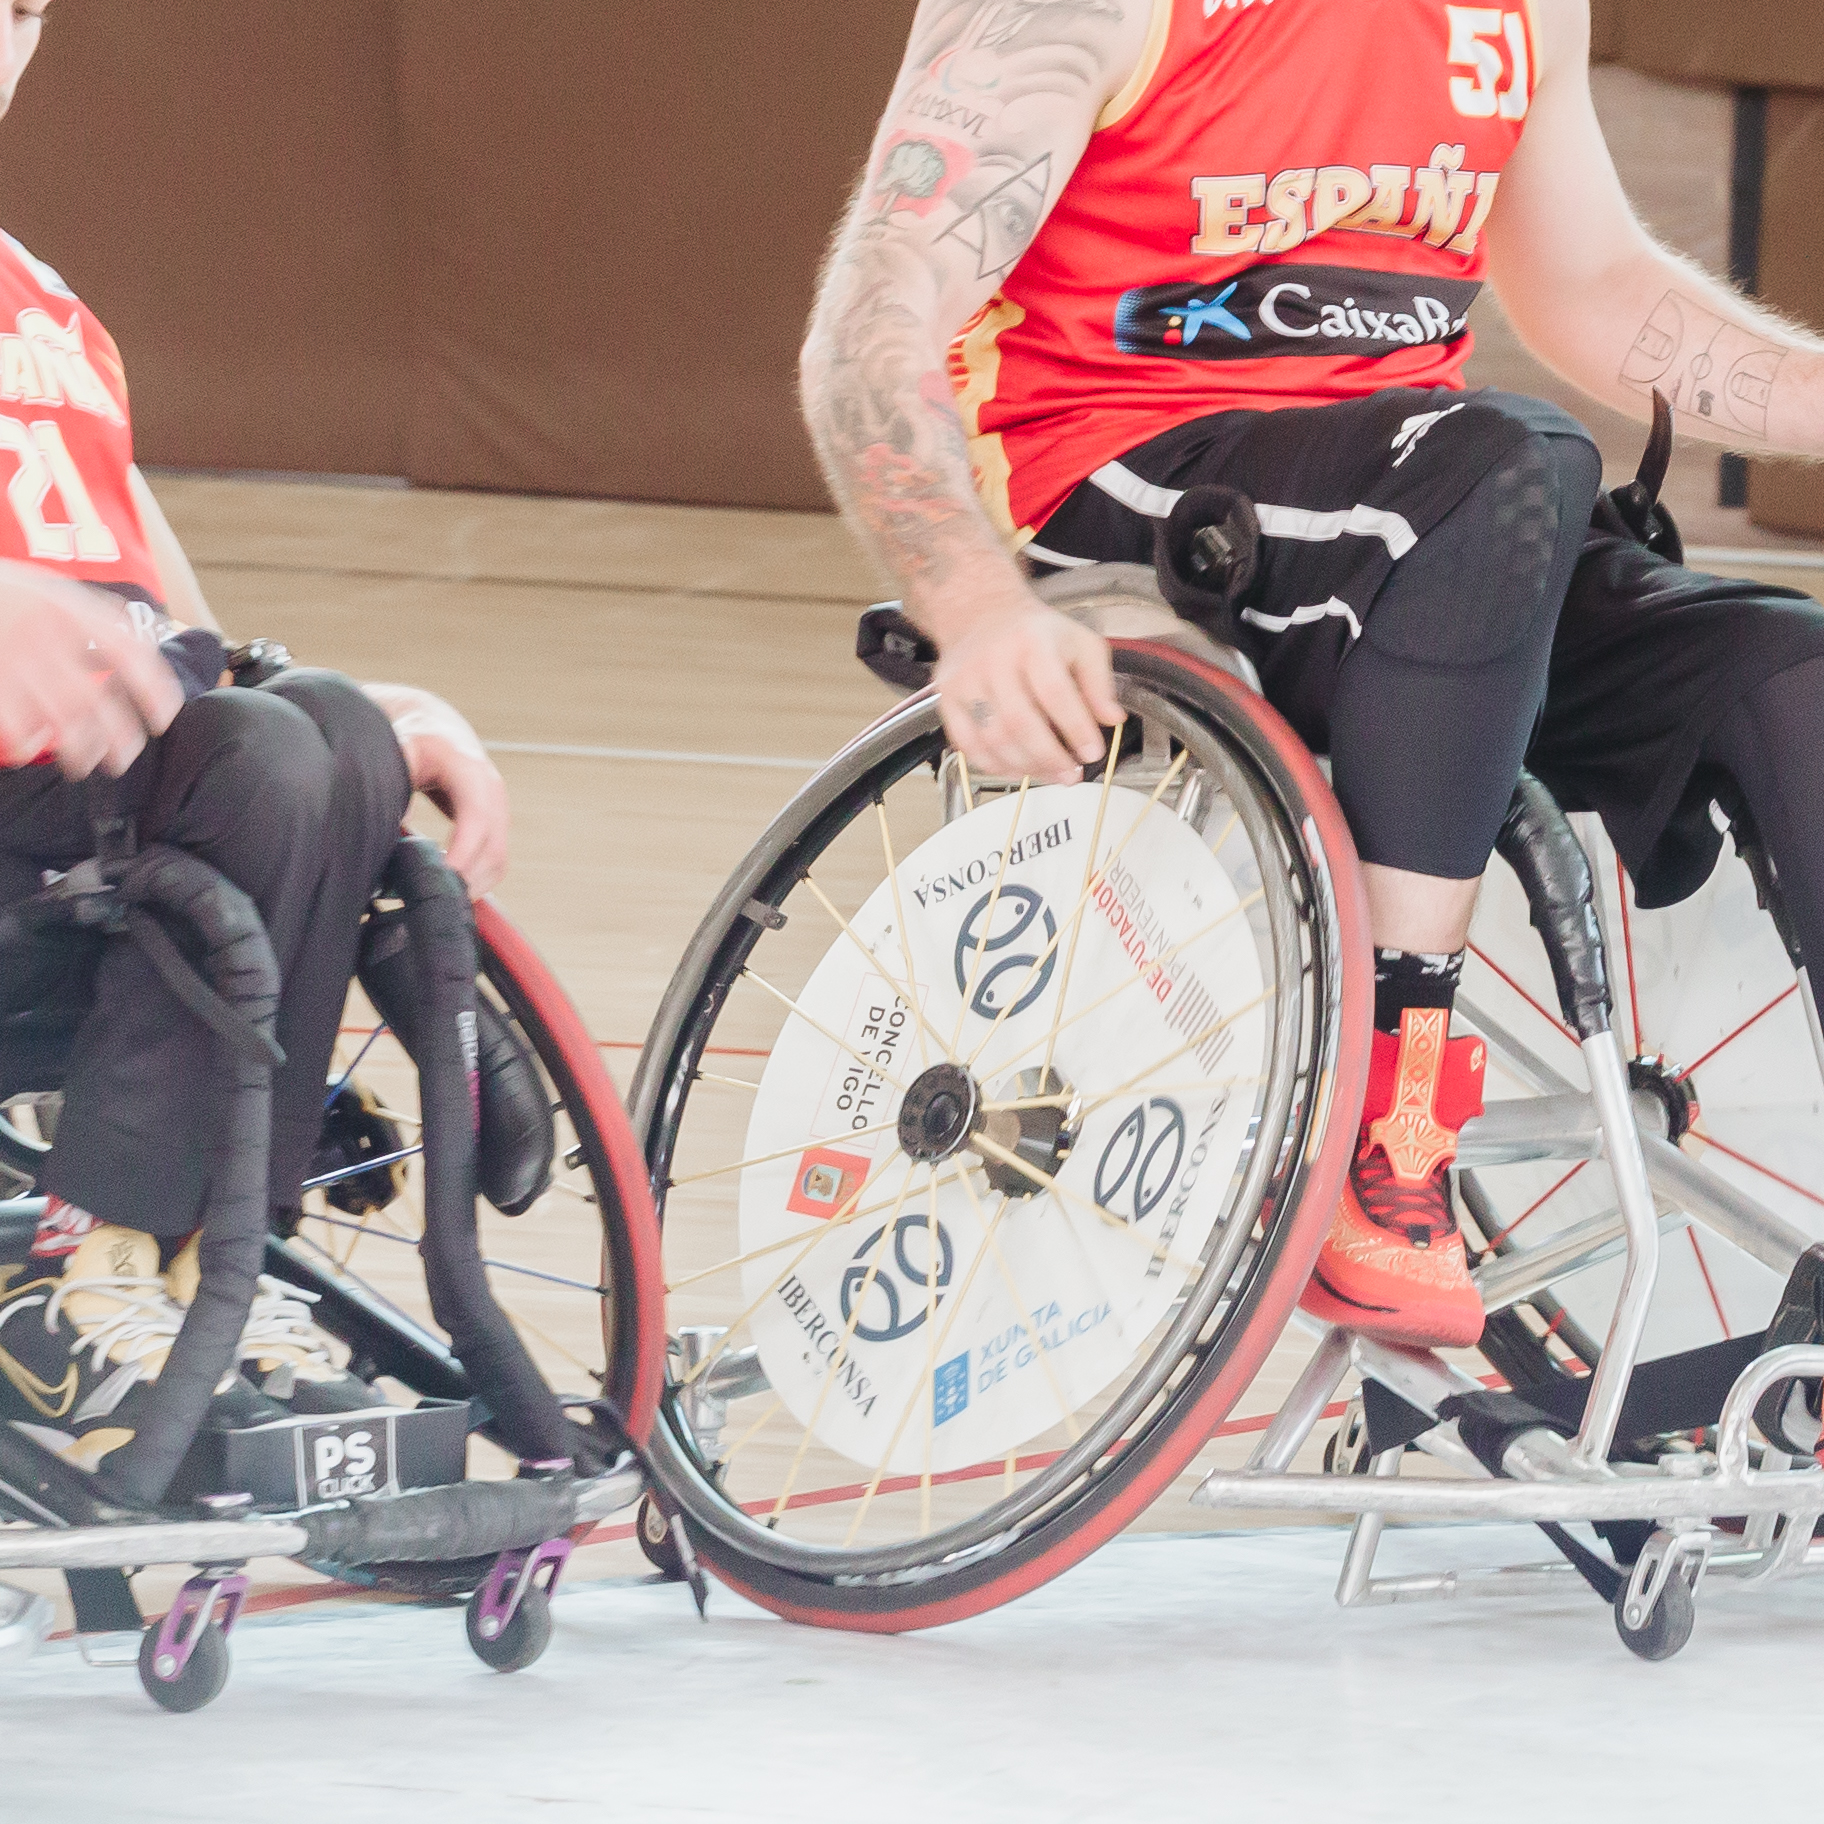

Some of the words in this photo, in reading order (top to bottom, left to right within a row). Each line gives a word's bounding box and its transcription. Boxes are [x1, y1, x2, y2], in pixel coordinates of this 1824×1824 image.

[1445, 4, 1531, 121] 51
[0, 414, 122, 563] 21
[912, 817, 1073, 909] IBERCONSA
[860, 1005, 886, 1040] DE
[778, 1274, 880, 1418] IBERCONSA
[978, 1299, 1063, 1366] XUNTA
[977, 1357, 1009, 1394] DE
[315, 1430, 377, 1481] PS
